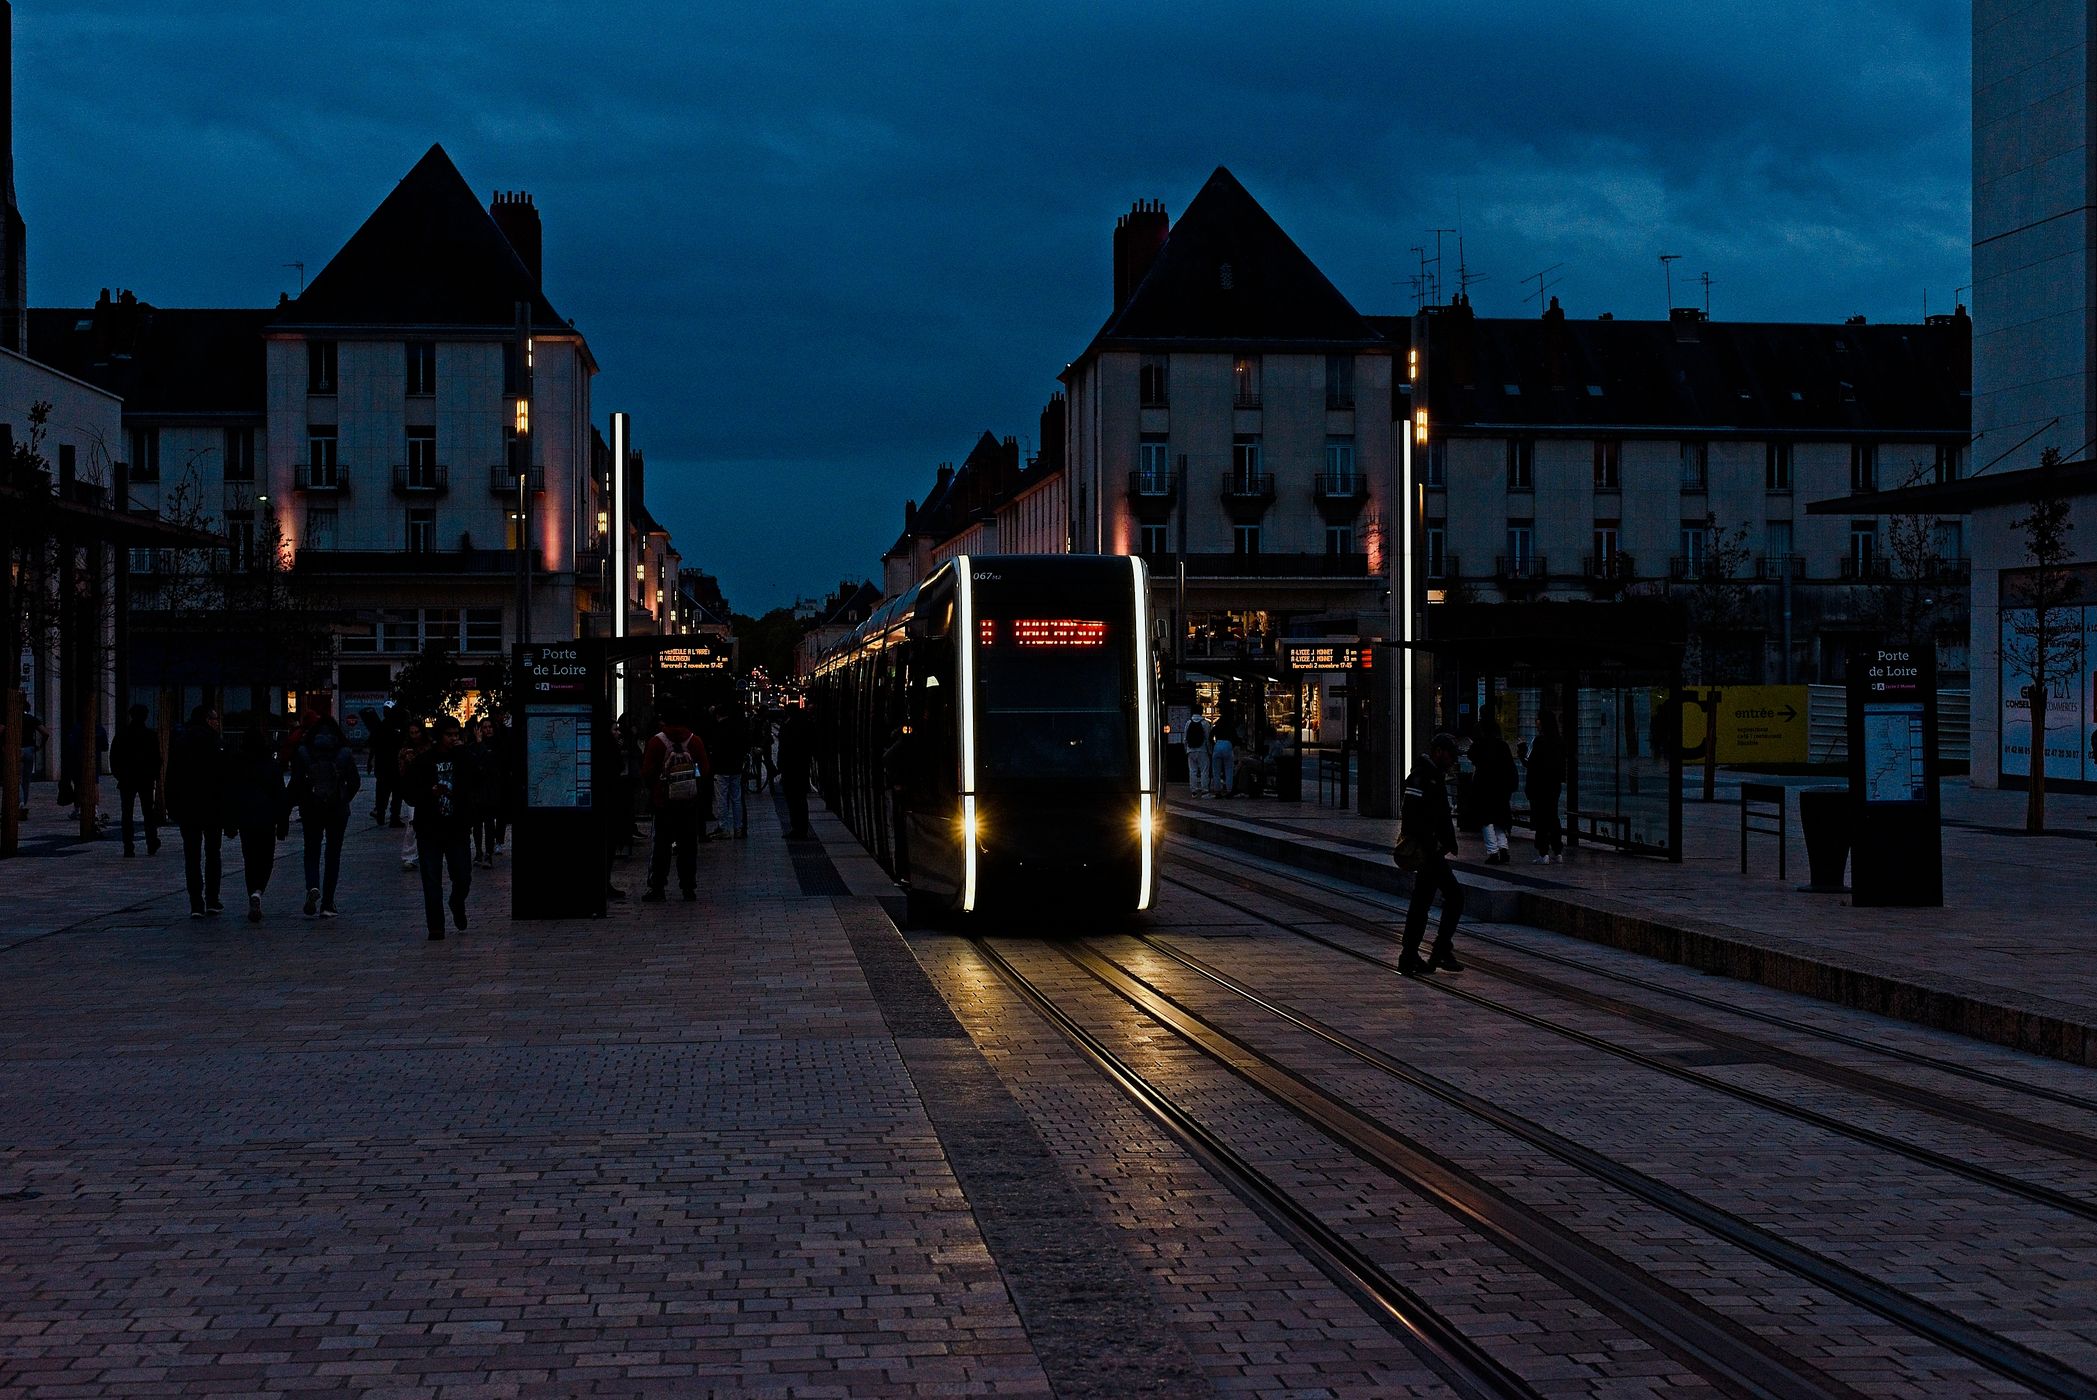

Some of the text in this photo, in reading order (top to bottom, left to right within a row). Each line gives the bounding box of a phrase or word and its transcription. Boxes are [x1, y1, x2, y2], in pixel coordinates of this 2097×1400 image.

[972, 572, 992, 580] 067
[542, 648, 577, 660] Porte
[1877, 650, 1910, 661] Porte
[533, 664, 586, 675] de Loire
[1869, 665, 1918, 677] de Loire
[1735, 708, 1775, 719] entrée
